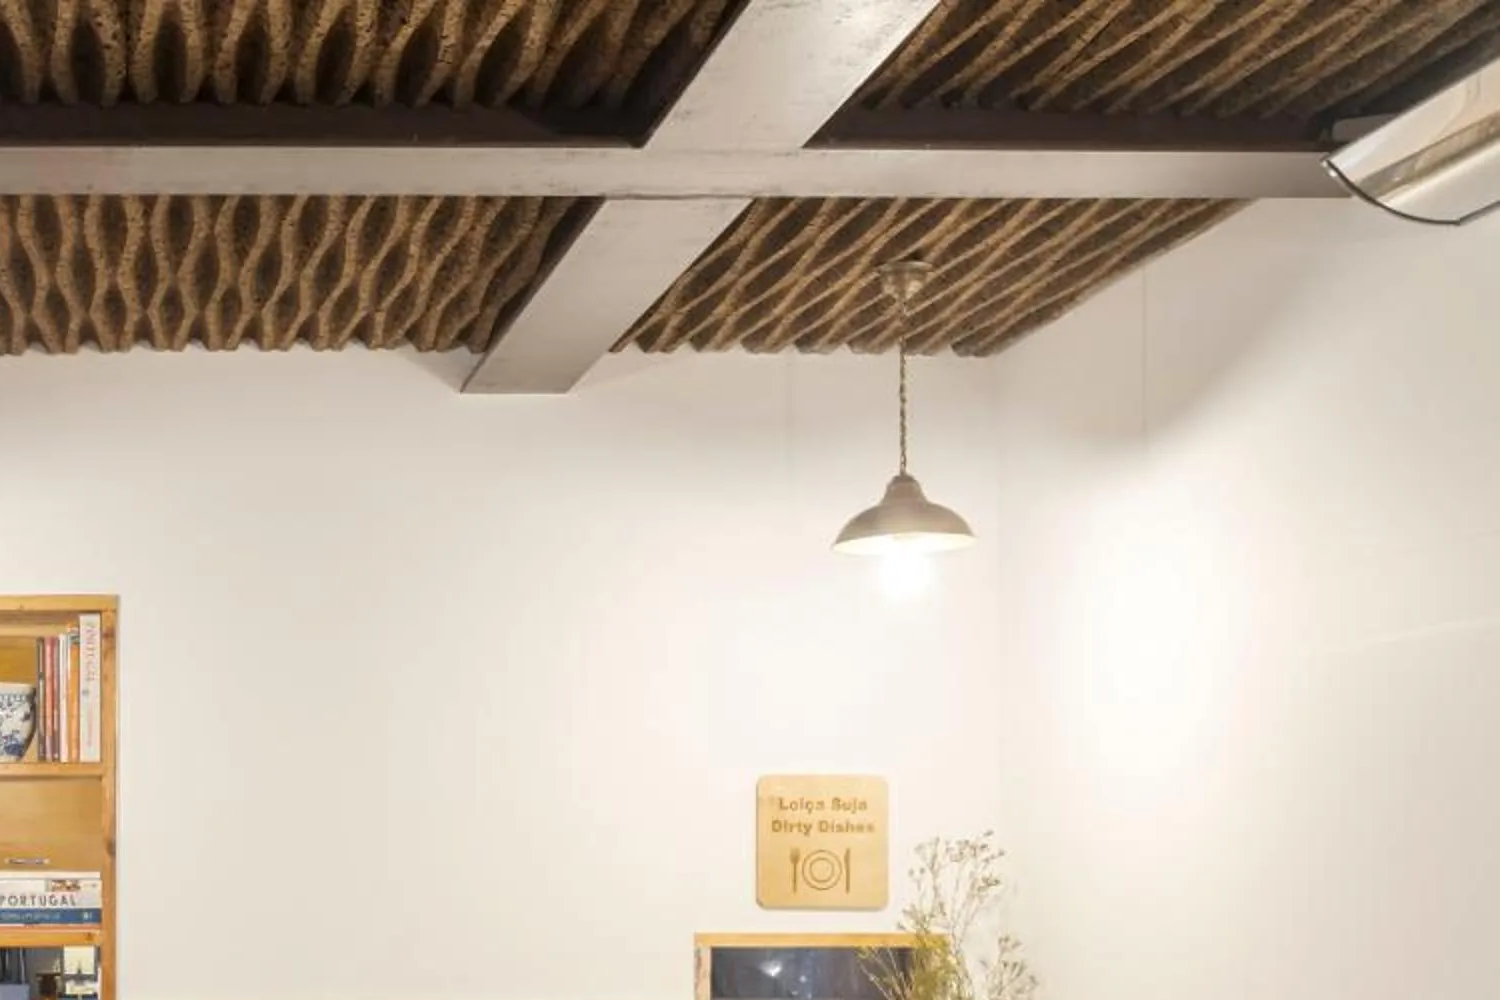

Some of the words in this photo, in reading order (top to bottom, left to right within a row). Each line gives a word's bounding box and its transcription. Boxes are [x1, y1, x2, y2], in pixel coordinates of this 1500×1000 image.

[831, 797, 868, 814] Suja
[771, 820, 813, 836] Dirty
[817, 820, 875, 834] Dishes
